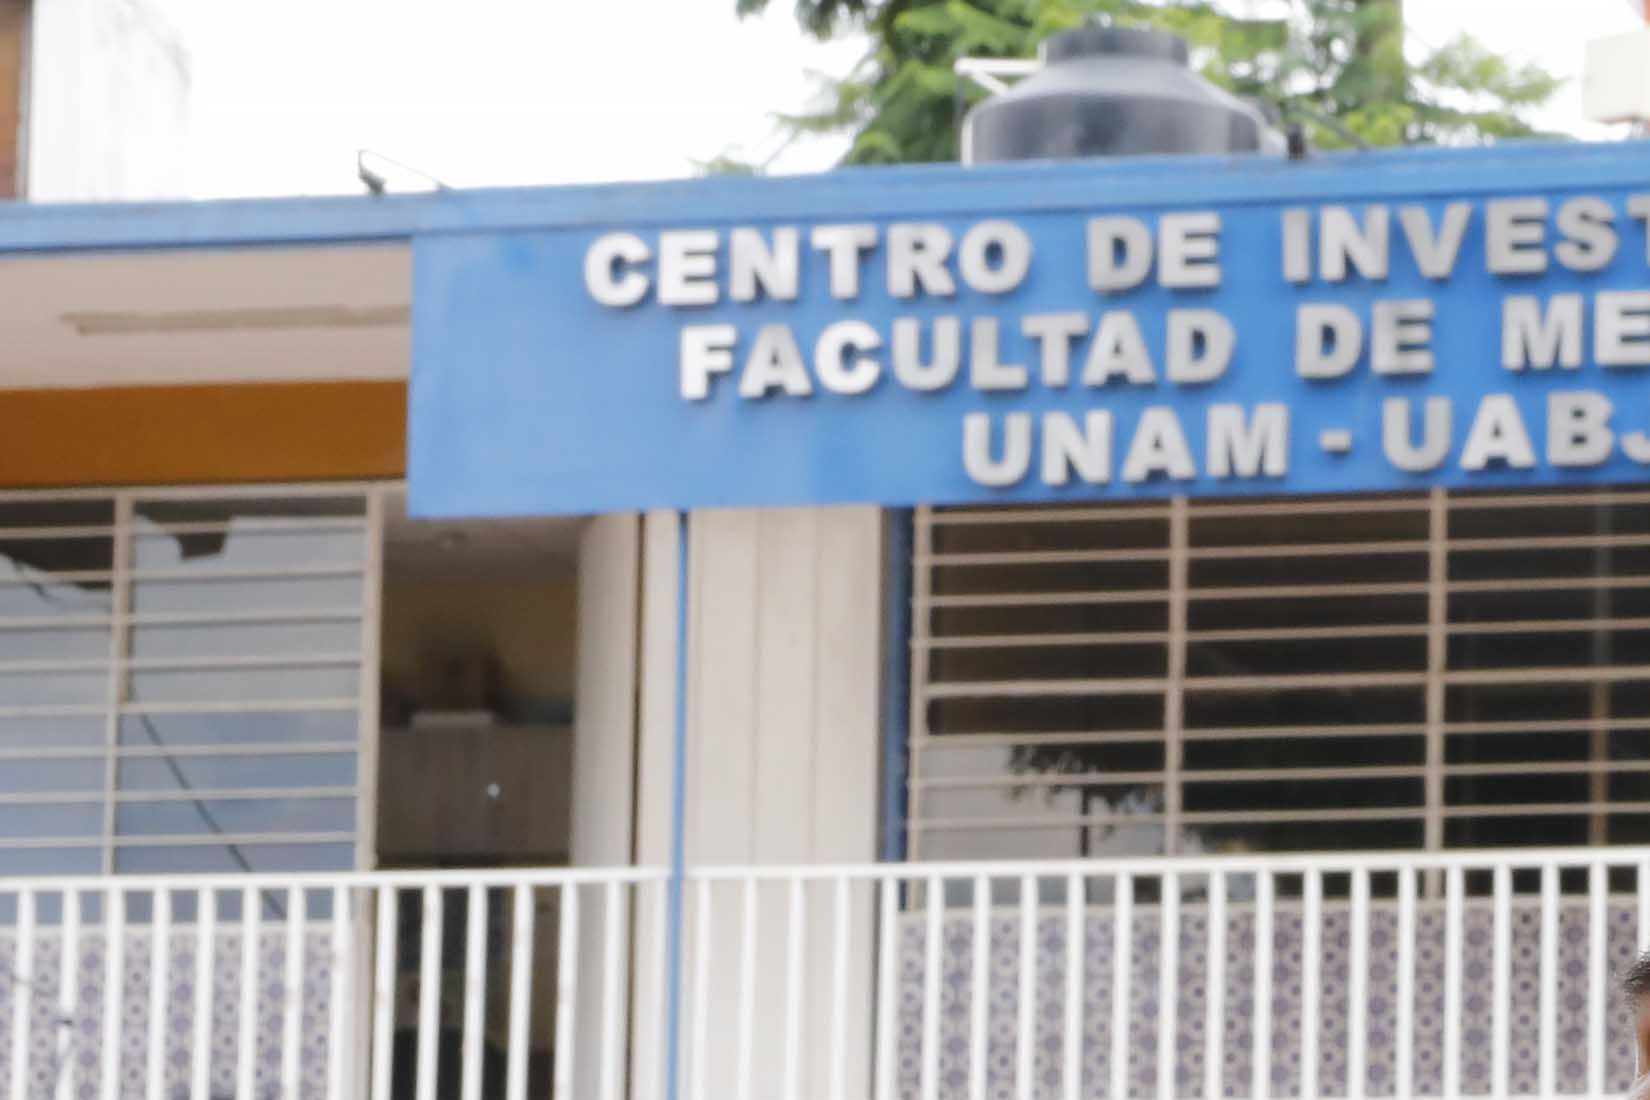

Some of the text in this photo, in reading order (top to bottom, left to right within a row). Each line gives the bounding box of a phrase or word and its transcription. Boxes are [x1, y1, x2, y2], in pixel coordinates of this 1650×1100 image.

[582, 217, 1034, 311] CENTRO
[1086, 211, 1222, 295] DE
[675, 307, 1236, 403] FACULTAD
[1295, 298, 1435, 380] DE
